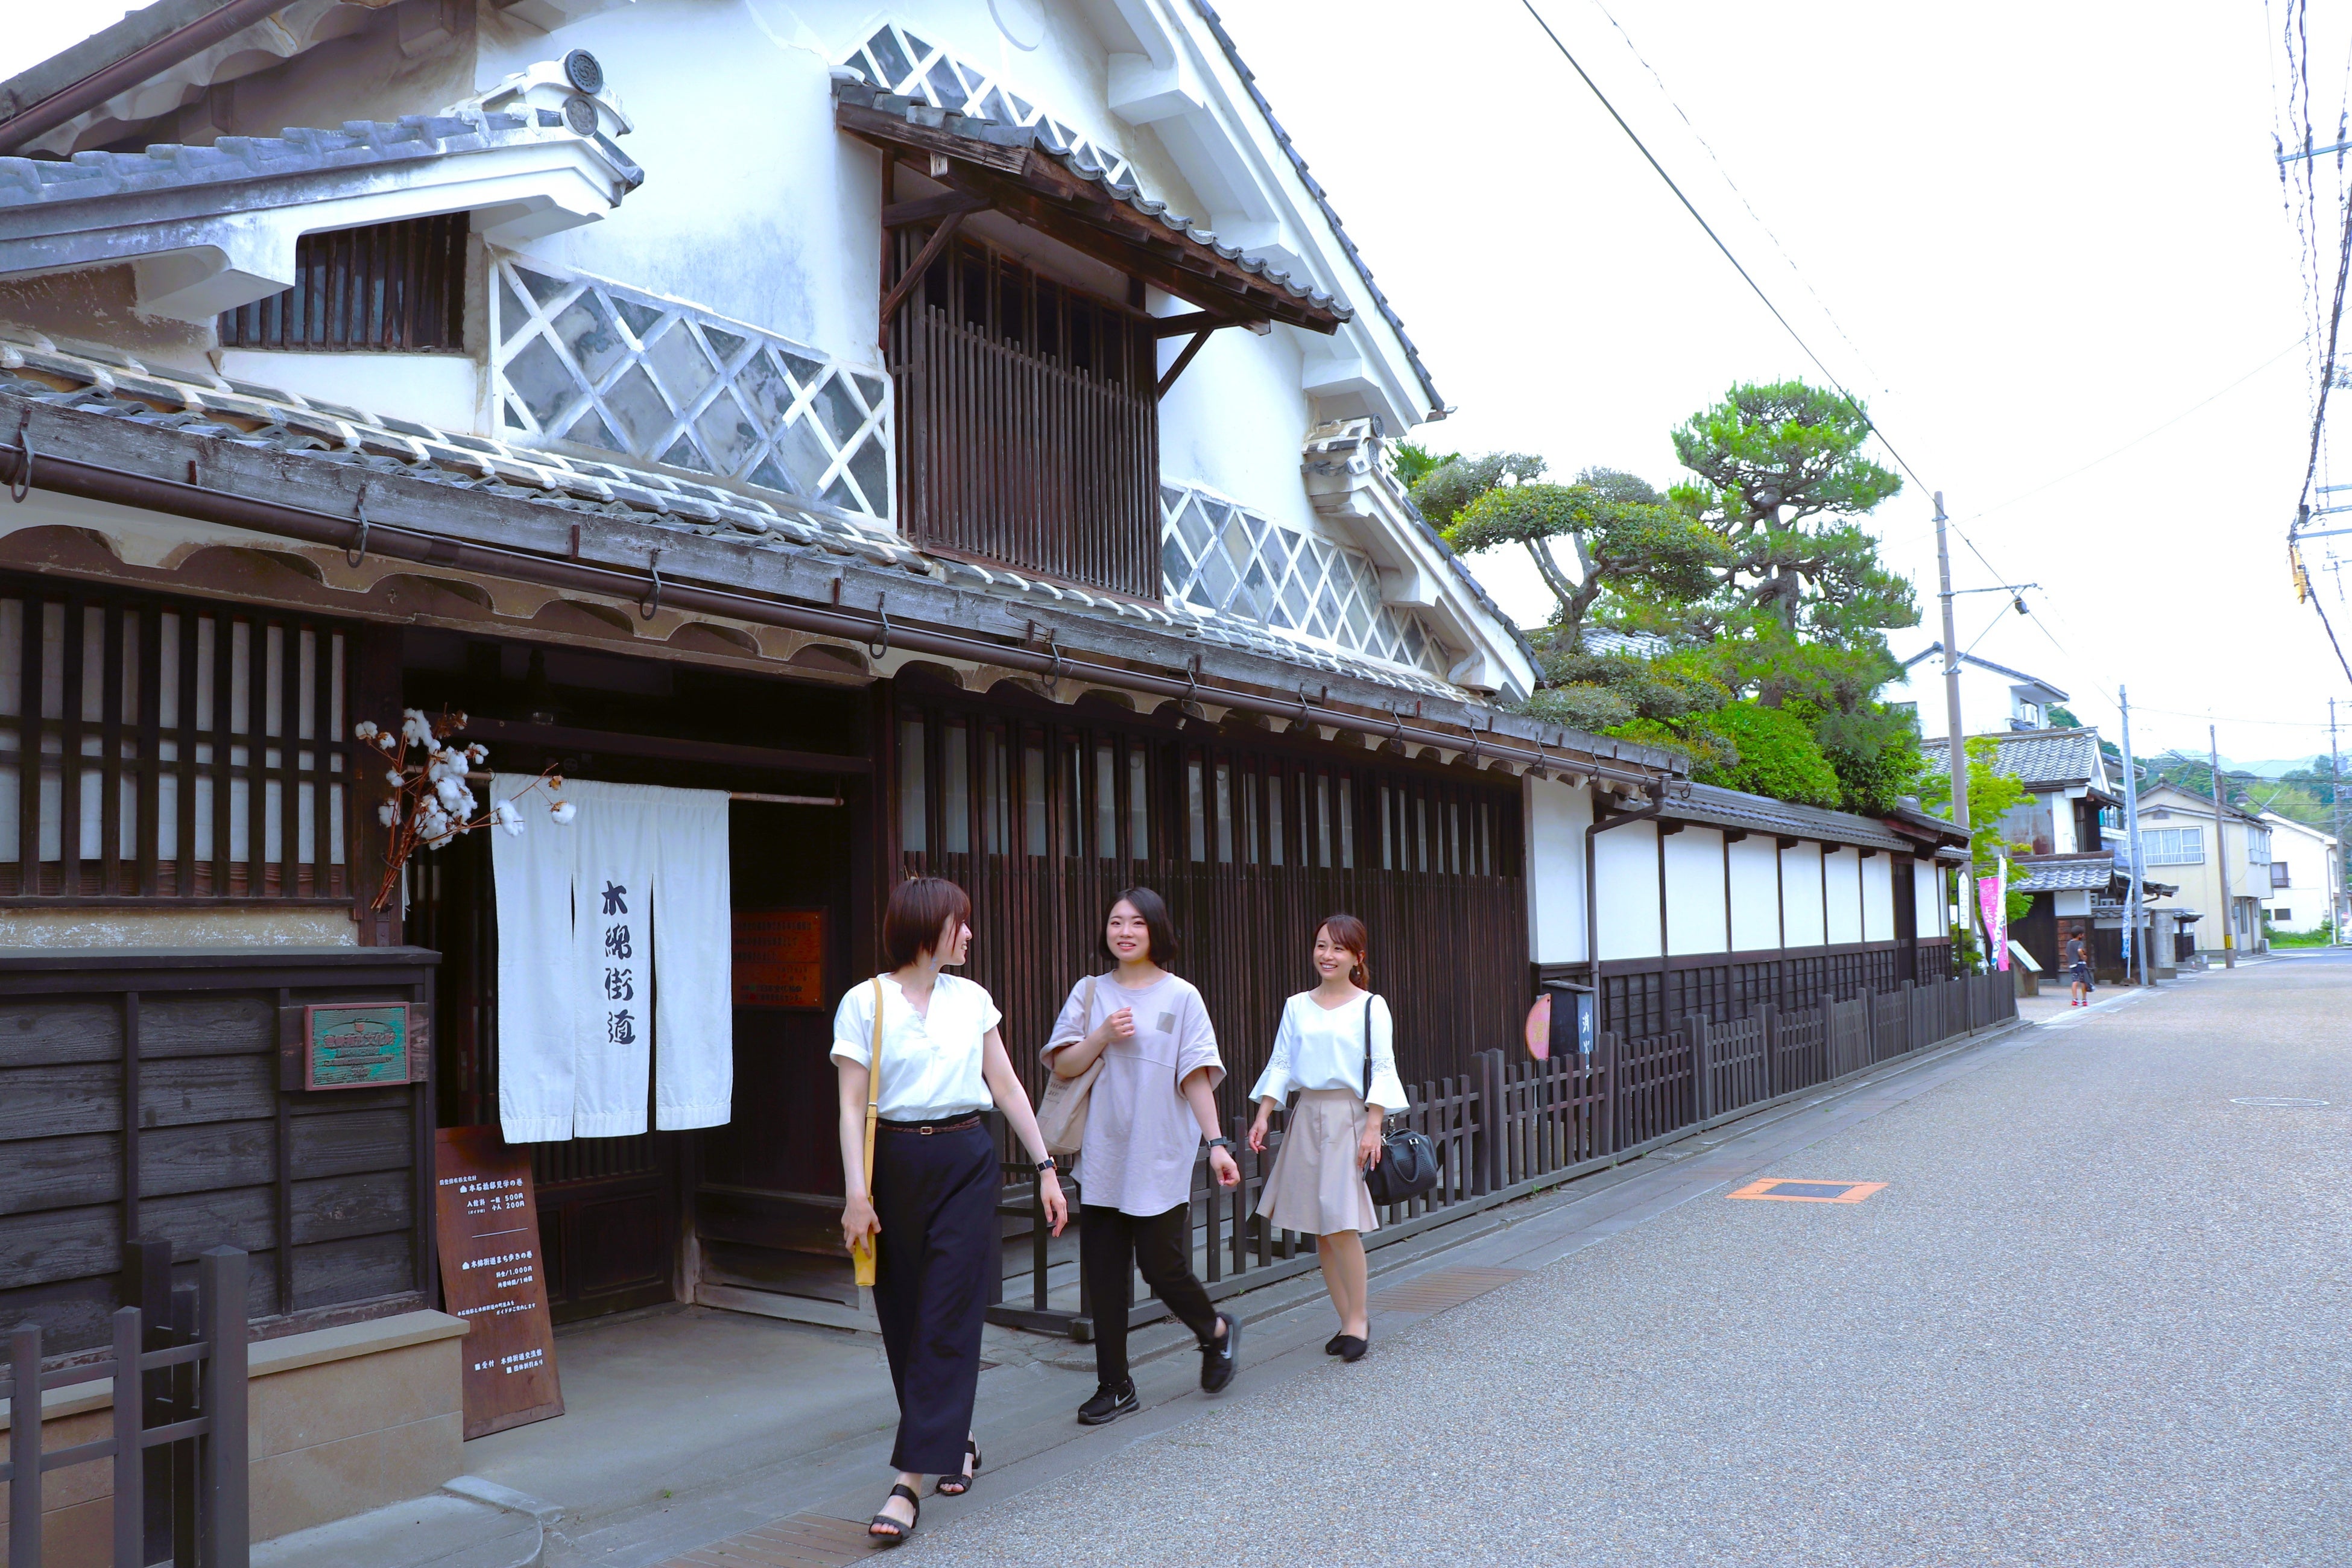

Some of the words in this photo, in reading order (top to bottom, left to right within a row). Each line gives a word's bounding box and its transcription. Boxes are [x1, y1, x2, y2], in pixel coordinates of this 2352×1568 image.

[602, 880, 636, 1045] 木綿街道
[505, 1193, 523, 1201] 500円
[506, 1201, 524, 1209] 200円
[482, 1360, 494, 1369] 受付
[501, 1348, 542, 1364] 木綿街道交流館
[514, 1359, 543, 1371] 団体割引あり
